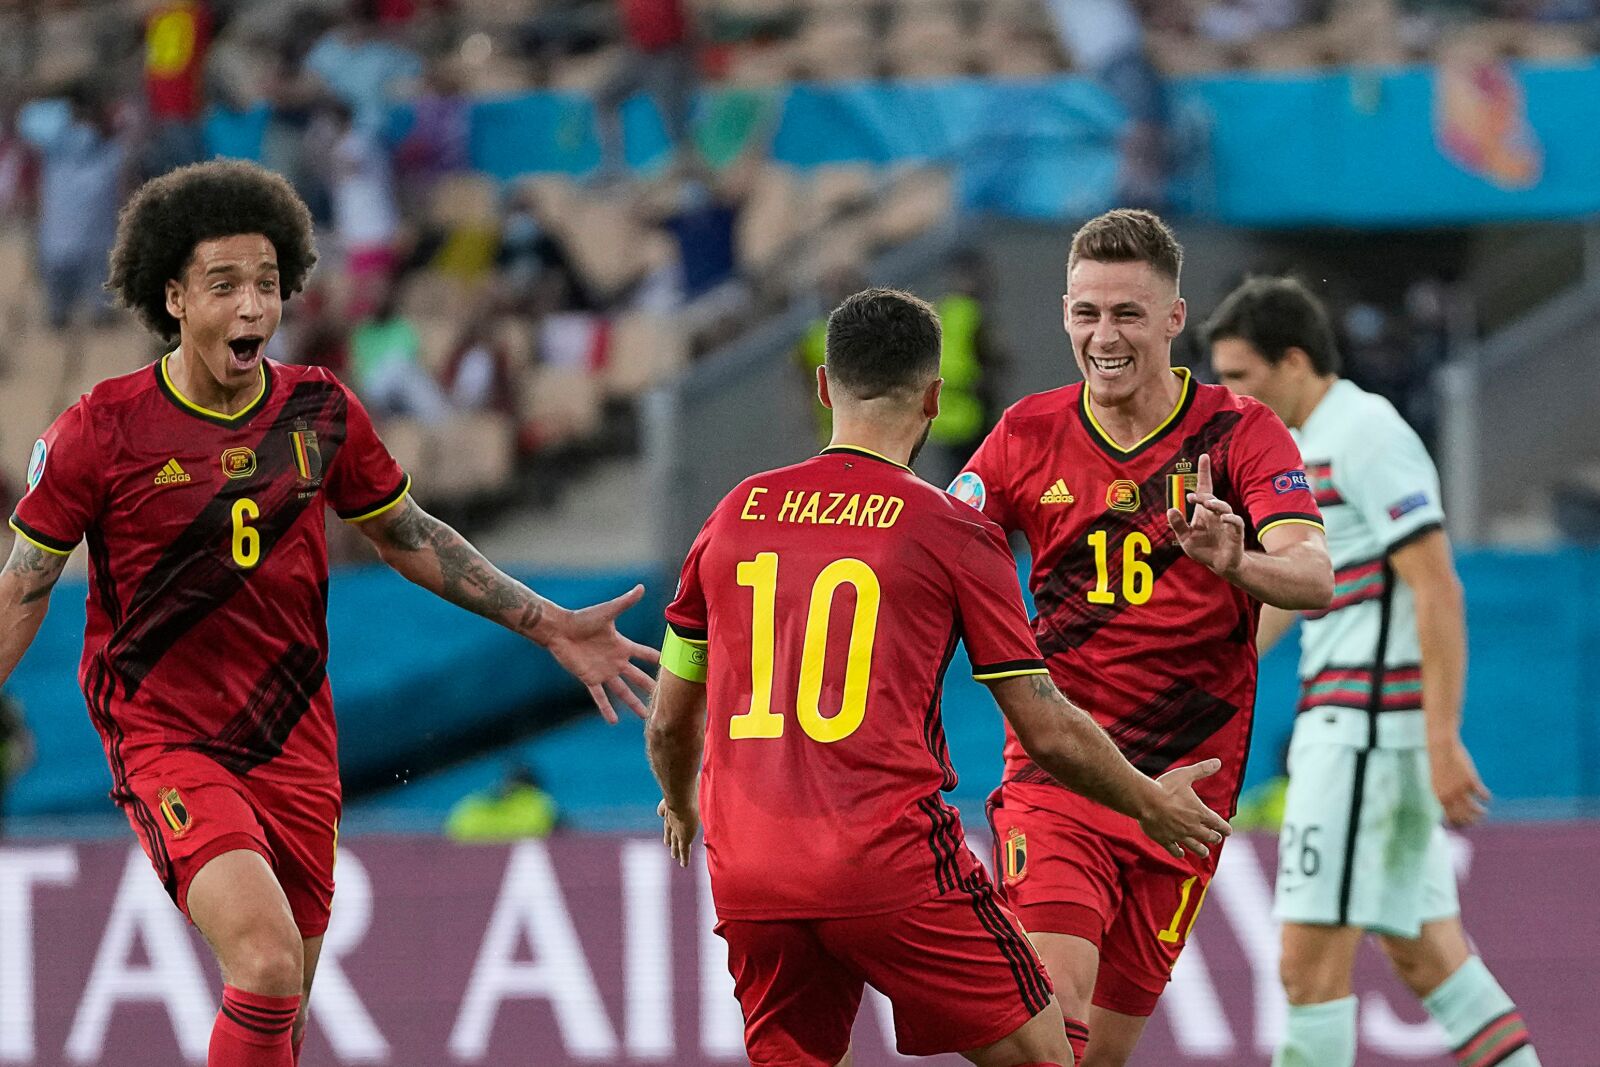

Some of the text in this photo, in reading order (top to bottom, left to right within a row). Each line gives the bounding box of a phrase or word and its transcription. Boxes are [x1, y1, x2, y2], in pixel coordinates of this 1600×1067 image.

[154, 473, 191, 485] adidas
[1040, 494, 1074, 504] adidas
[231, 498, 260, 568] 6
[741, 487, 905, 528] E. HAZARD
[1087, 530, 1153, 605] 16
[729, 552, 881, 743] 10
